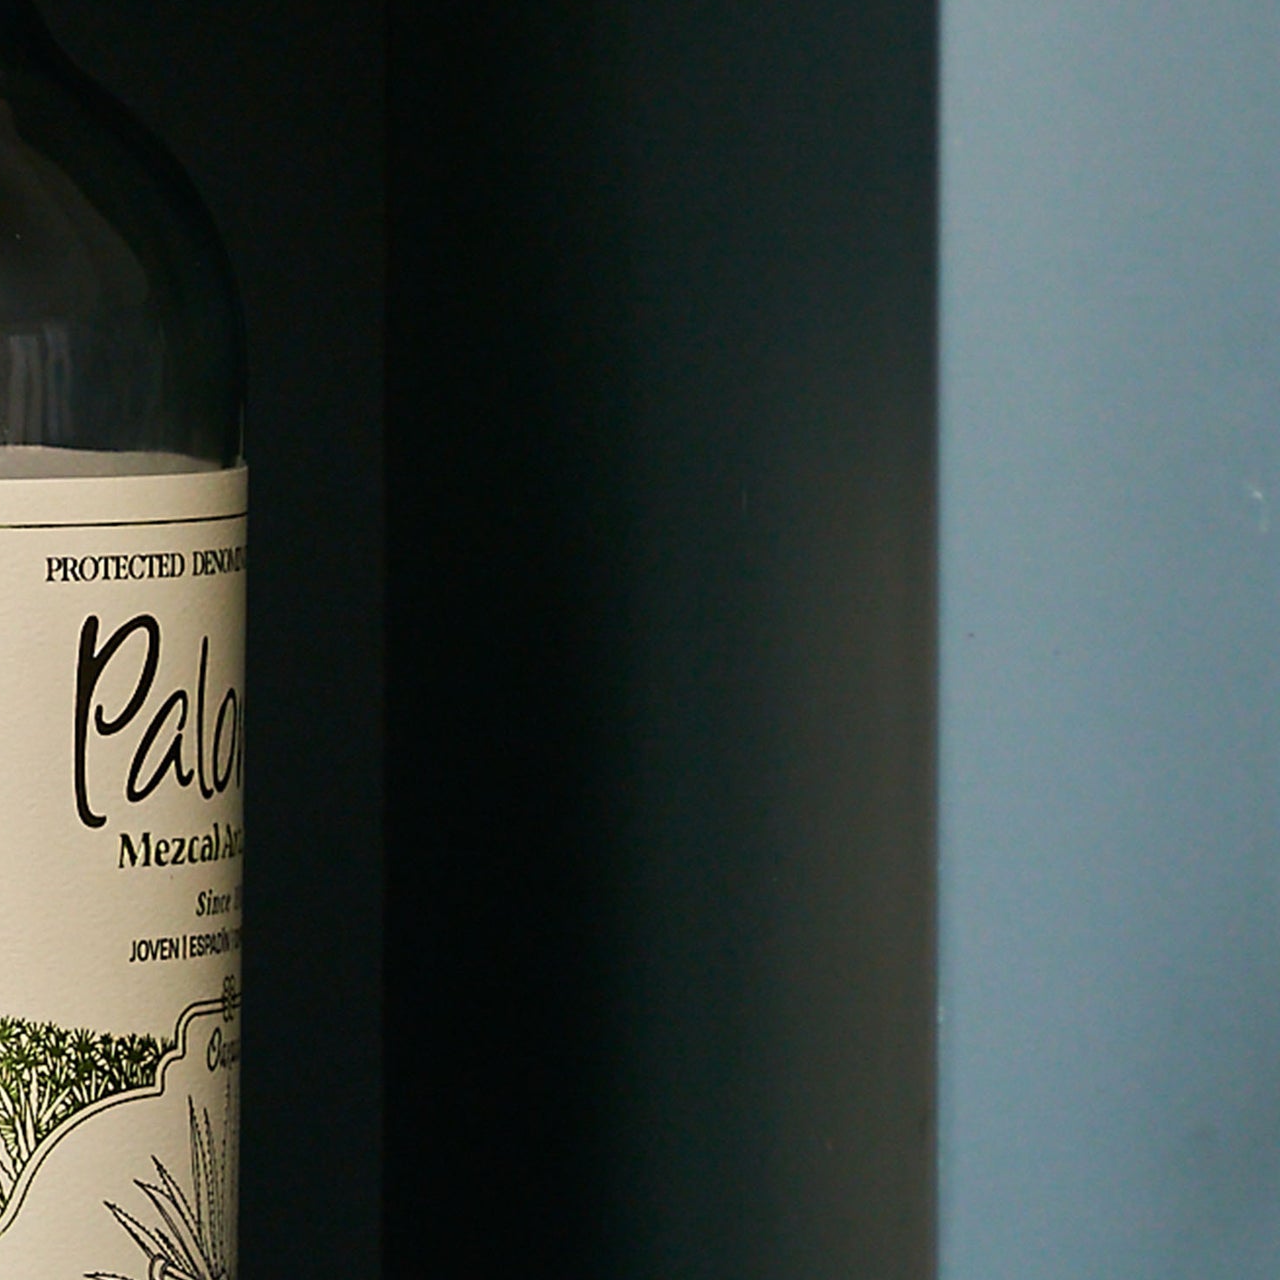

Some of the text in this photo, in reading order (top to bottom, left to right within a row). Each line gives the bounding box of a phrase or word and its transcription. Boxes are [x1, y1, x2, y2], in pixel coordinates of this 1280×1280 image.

[45, 553, 185, 582] PROTECTED
[74, 614, 242, 829] Palo
[118, 822, 220, 869] Mezcal
[129, 936, 180, 962] JOVEN
